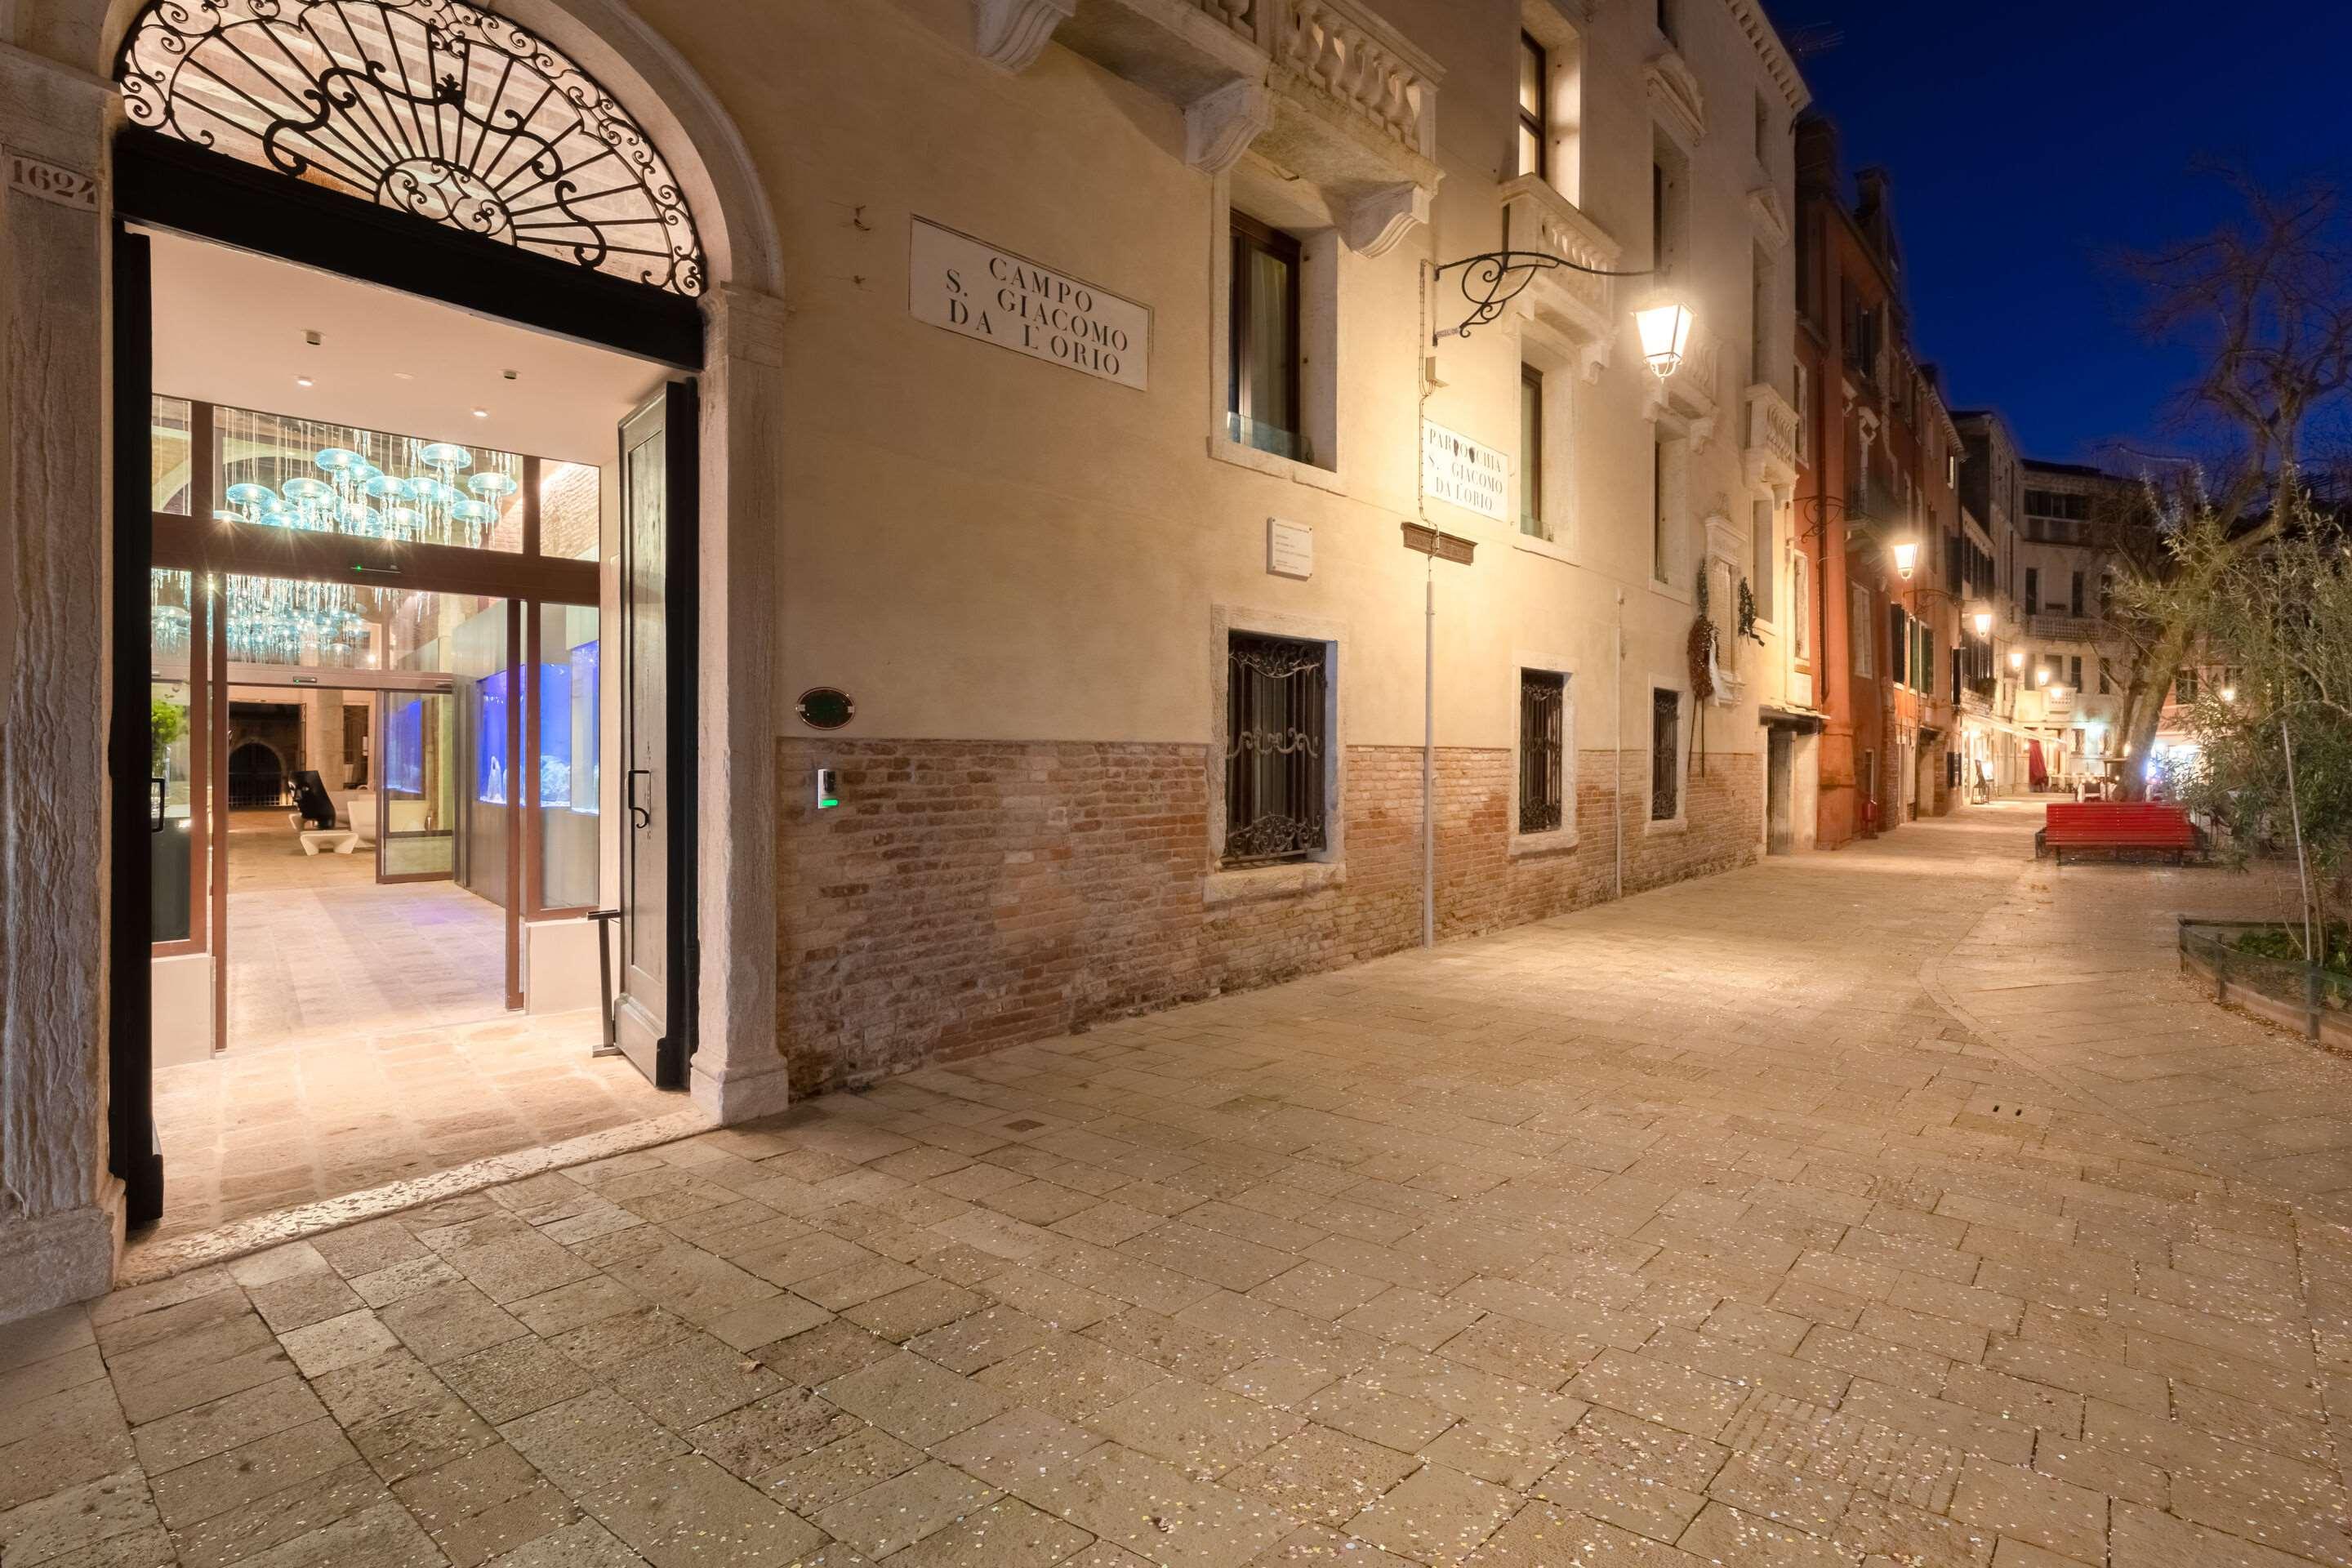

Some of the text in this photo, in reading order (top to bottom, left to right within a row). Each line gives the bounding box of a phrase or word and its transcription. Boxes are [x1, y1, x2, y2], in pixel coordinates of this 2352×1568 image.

[989, 256, 1093, 313] CAMPO
[946, 268, 1128, 352] S. GIACOMO
[947, 297, 993, 335] DA
[1435, 476, 1451, 497] DA
[1451, 461, 1503, 495] GIACOMO
